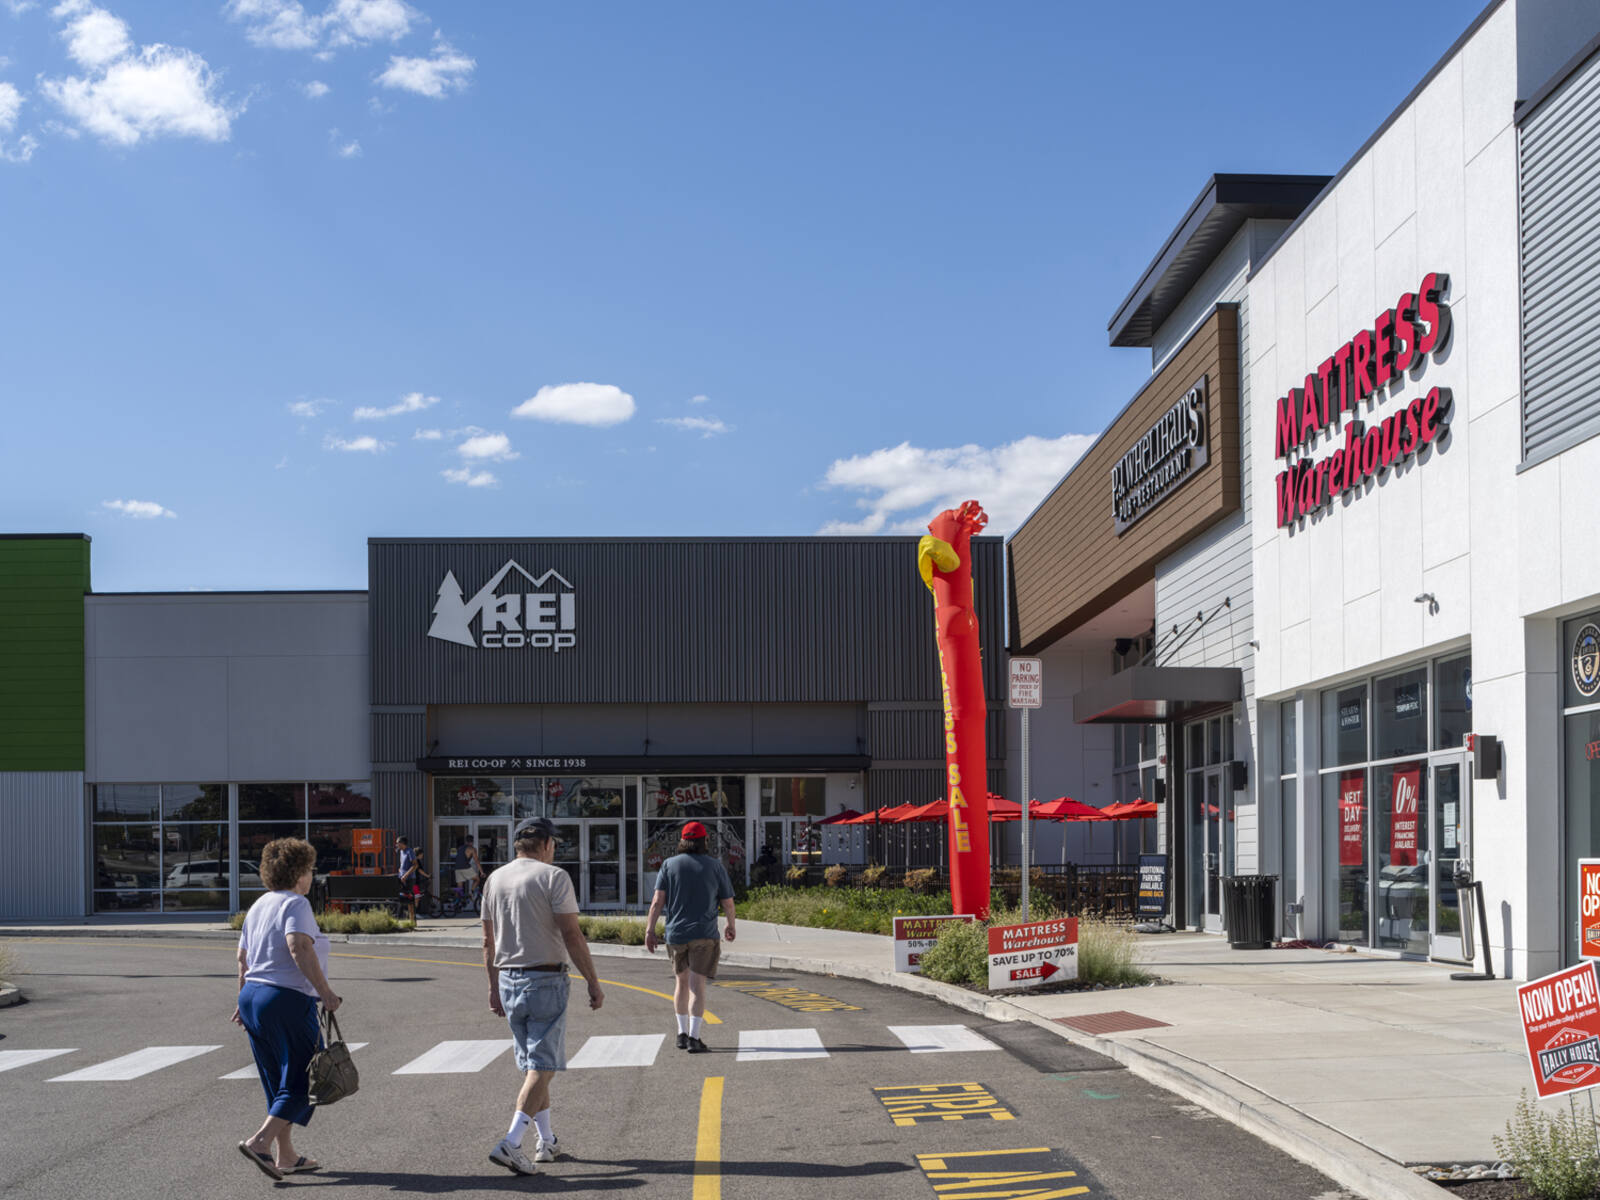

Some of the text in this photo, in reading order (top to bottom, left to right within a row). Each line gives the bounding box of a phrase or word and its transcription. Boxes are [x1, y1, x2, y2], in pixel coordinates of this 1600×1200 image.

[1275, 272, 1446, 460] MATTRESS
[1275, 386, 1446, 528] Warehouse
[1137, 449, 1187, 507] RESTAURANT
[482, 592, 576, 631] REI
[1019, 662, 1032, 673] NO
[1011, 674, 1040, 683] PARKING
[1585, 739, 1600, 761] OPE
[448, 758, 587, 768] REI CO-OP SINCE 1938
[674, 784, 709, 803] SALE
[1344, 790, 1361, 804] NEXT
[1395, 776, 1417, 814] 0%
[948, 763, 972, 852] SALE
[1344, 806, 1361, 822] DAY
[1394, 820, 1416, 830] INTEREST
[1394, 831, 1415, 839] FINANCING
[1394, 840, 1415, 849] AVAILABLE
[1139, 865, 1165, 874] ADDITIONAL
[1142, 874, 1162, 882] PARKING
[1140, 882, 1164, 890] AVAILABLE
[1583, 895, 1600, 917] OP
[1002, 921, 1066, 940] MATTRESS
[1002, 934, 1066, 950] Warehouse
[992, 946, 1075, 967] SAVE UP TO 70%
[1015, 967, 1042, 979] SALE
[1521, 970, 1597, 1024] NOW OPEN!
[1541, 1041, 1600, 1076] RALLY HOUSE
[873, 1082, 1017, 1126] FIRE
[915, 1147, 1091, 1200] LAN
